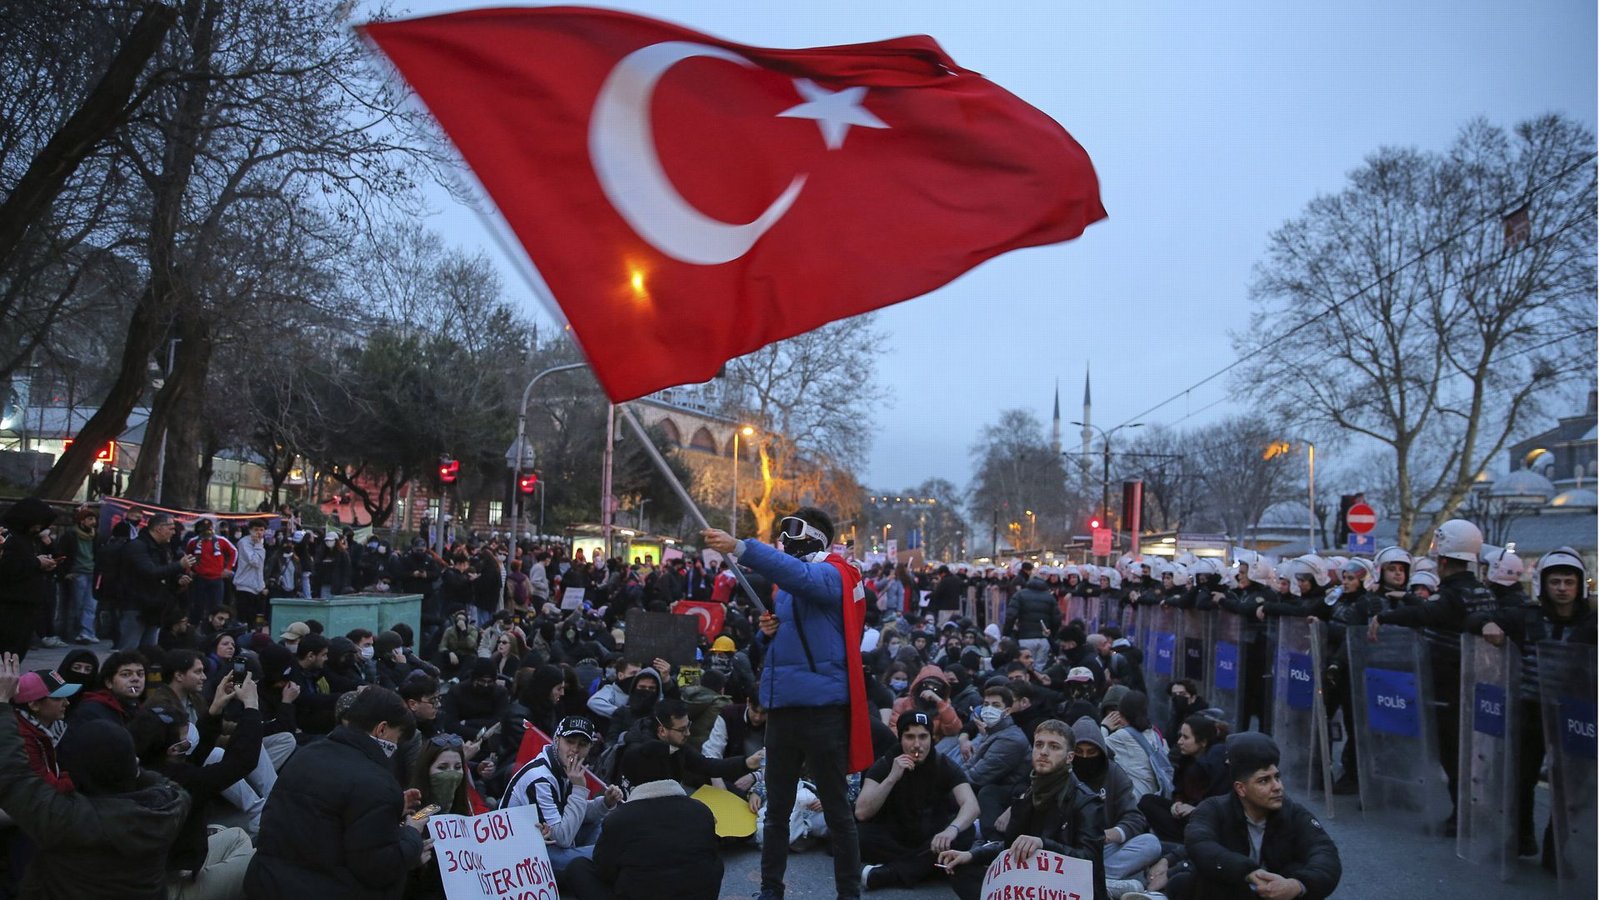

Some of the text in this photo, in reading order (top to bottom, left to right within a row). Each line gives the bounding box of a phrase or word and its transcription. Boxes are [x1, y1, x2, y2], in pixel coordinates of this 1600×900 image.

[1376, 695, 1406, 709] POLİS
[473, 811, 514, 843] GİBİ
[445, 850, 458, 872] 3
